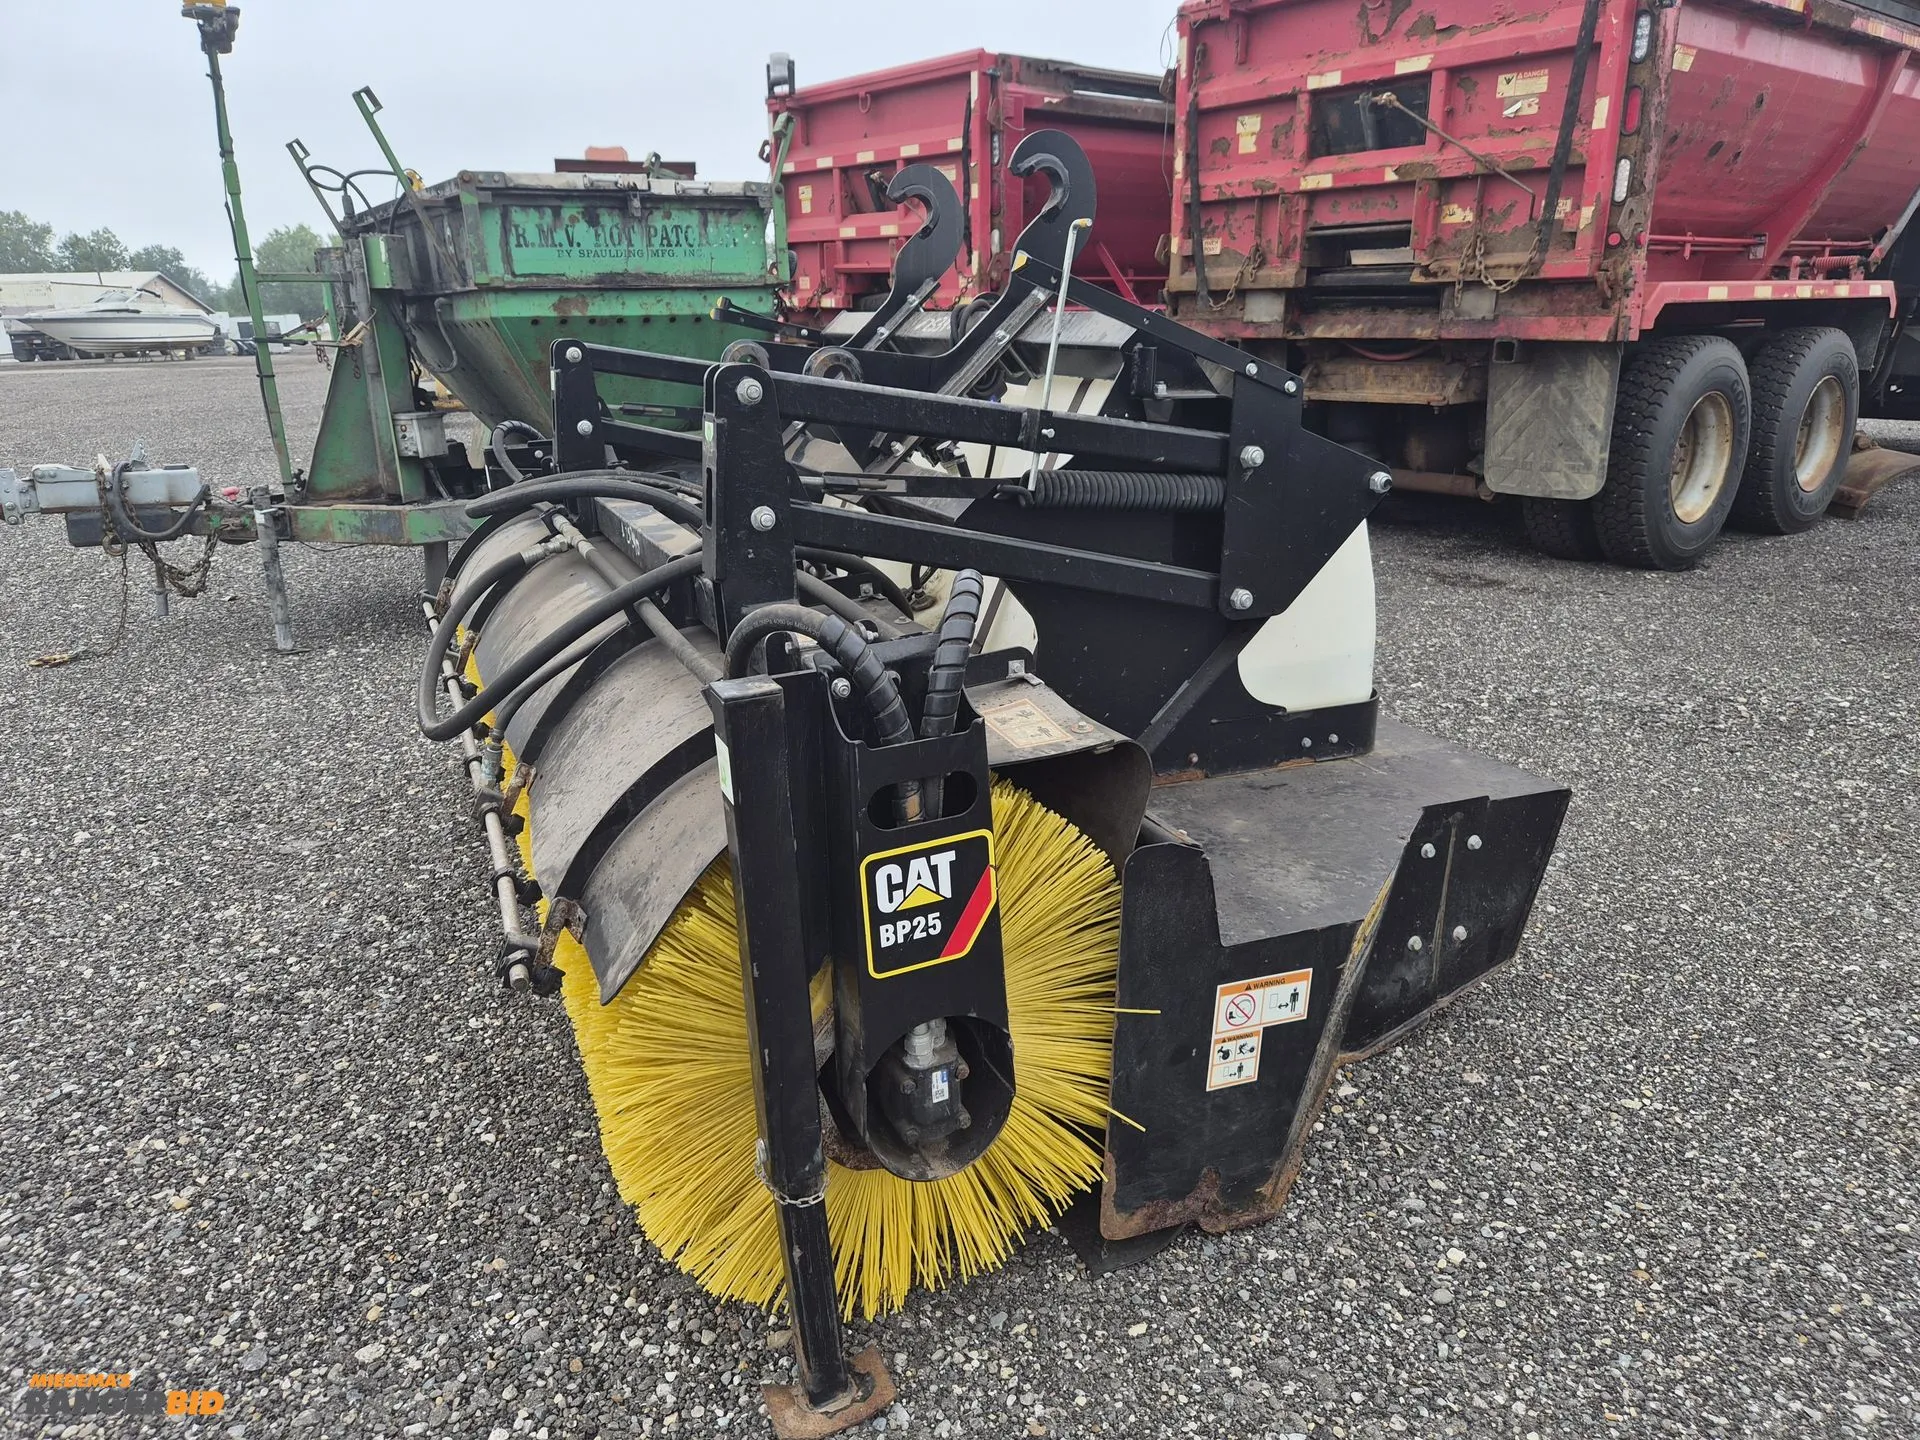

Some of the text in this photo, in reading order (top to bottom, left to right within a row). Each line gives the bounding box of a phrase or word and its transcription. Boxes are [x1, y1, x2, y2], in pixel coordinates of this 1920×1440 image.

[514, 224, 581, 248] R.M.V.
[647, 223, 738, 248] PATC
[578, 248, 644, 258] SPAULDING
[651, 248, 678, 258] MFG.
[875, 850, 956, 914] CAT
[879, 912, 942, 948] BP25
[1253, 978, 1286, 989] WARNING
[1226, 1032, 1254, 1043] WARNING
